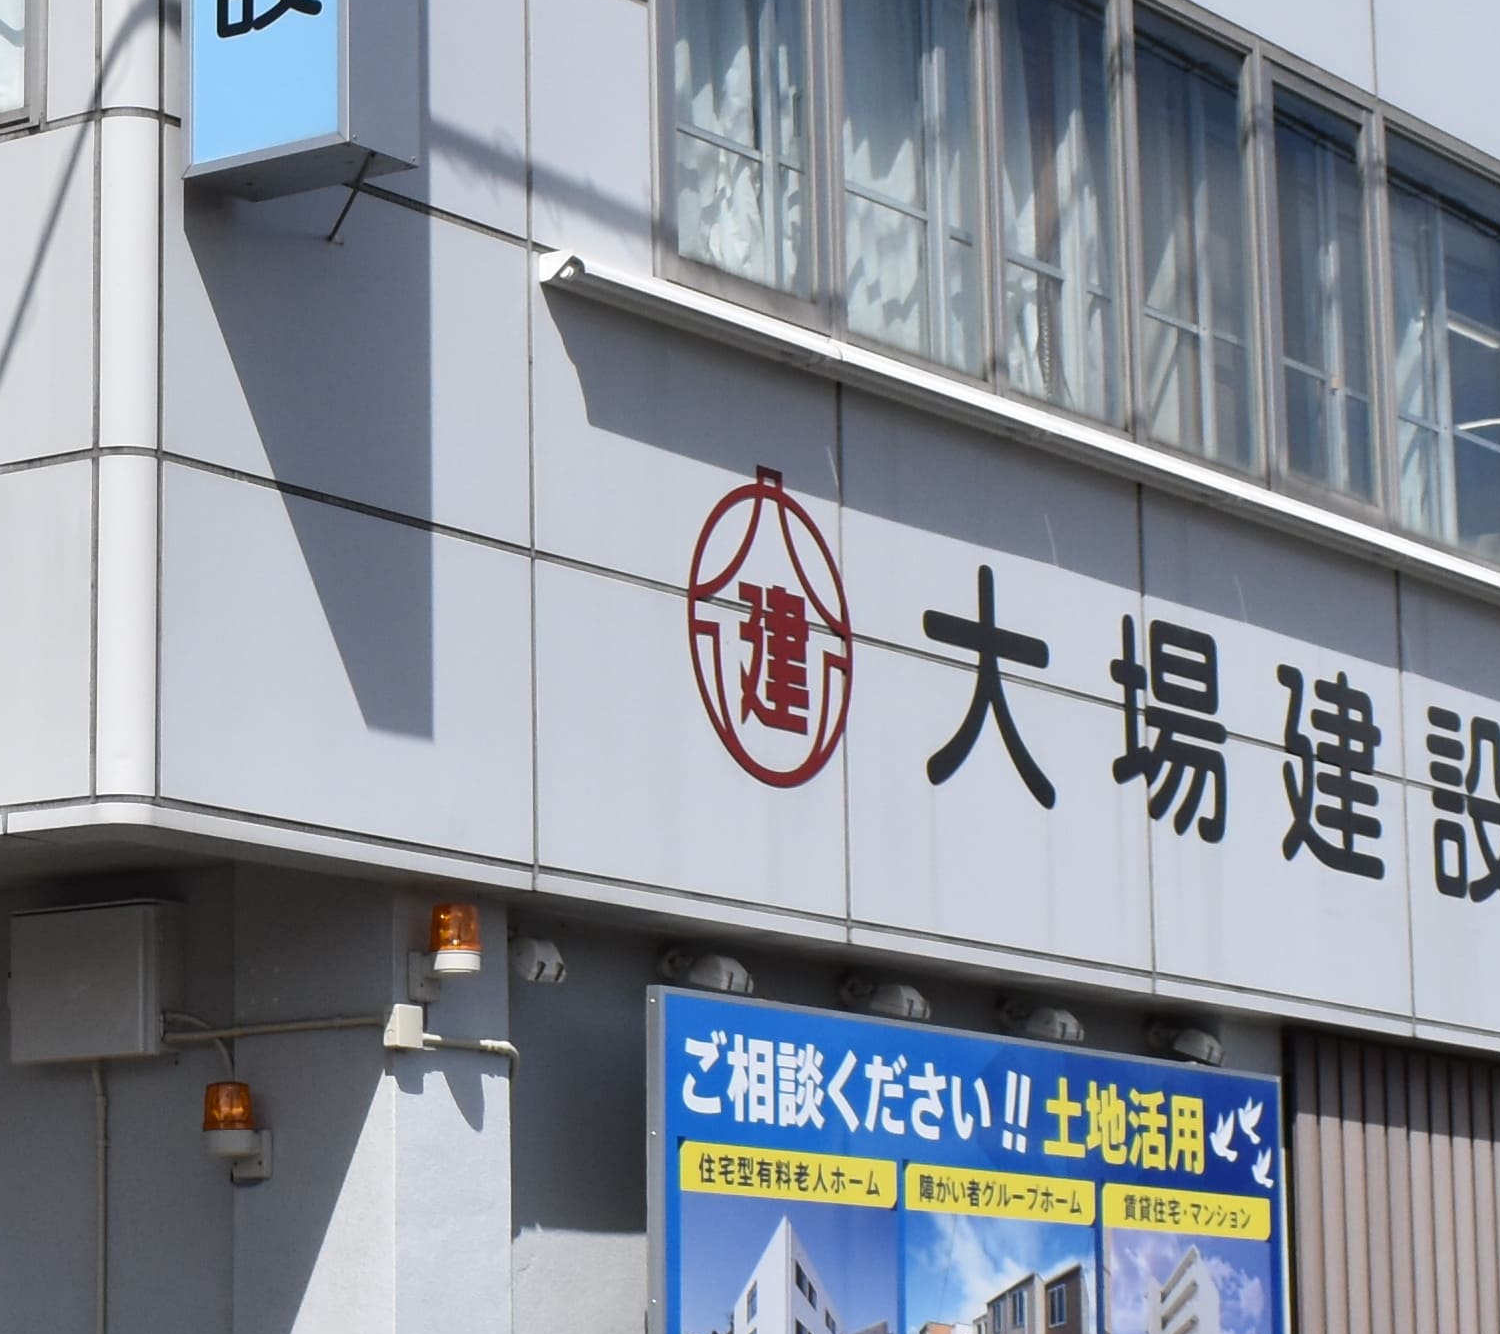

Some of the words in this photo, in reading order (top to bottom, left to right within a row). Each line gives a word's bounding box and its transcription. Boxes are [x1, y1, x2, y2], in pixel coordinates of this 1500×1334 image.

[1043, 1077, 1206, 1175] 土地活用
[698, 1151, 881, 1198] 住宅型有料老人ホーム
[919, 1174, 1083, 1216] 障がい者グループホーム
[1123, 1194, 1252, 1230] 賃貸住宅・マンション
